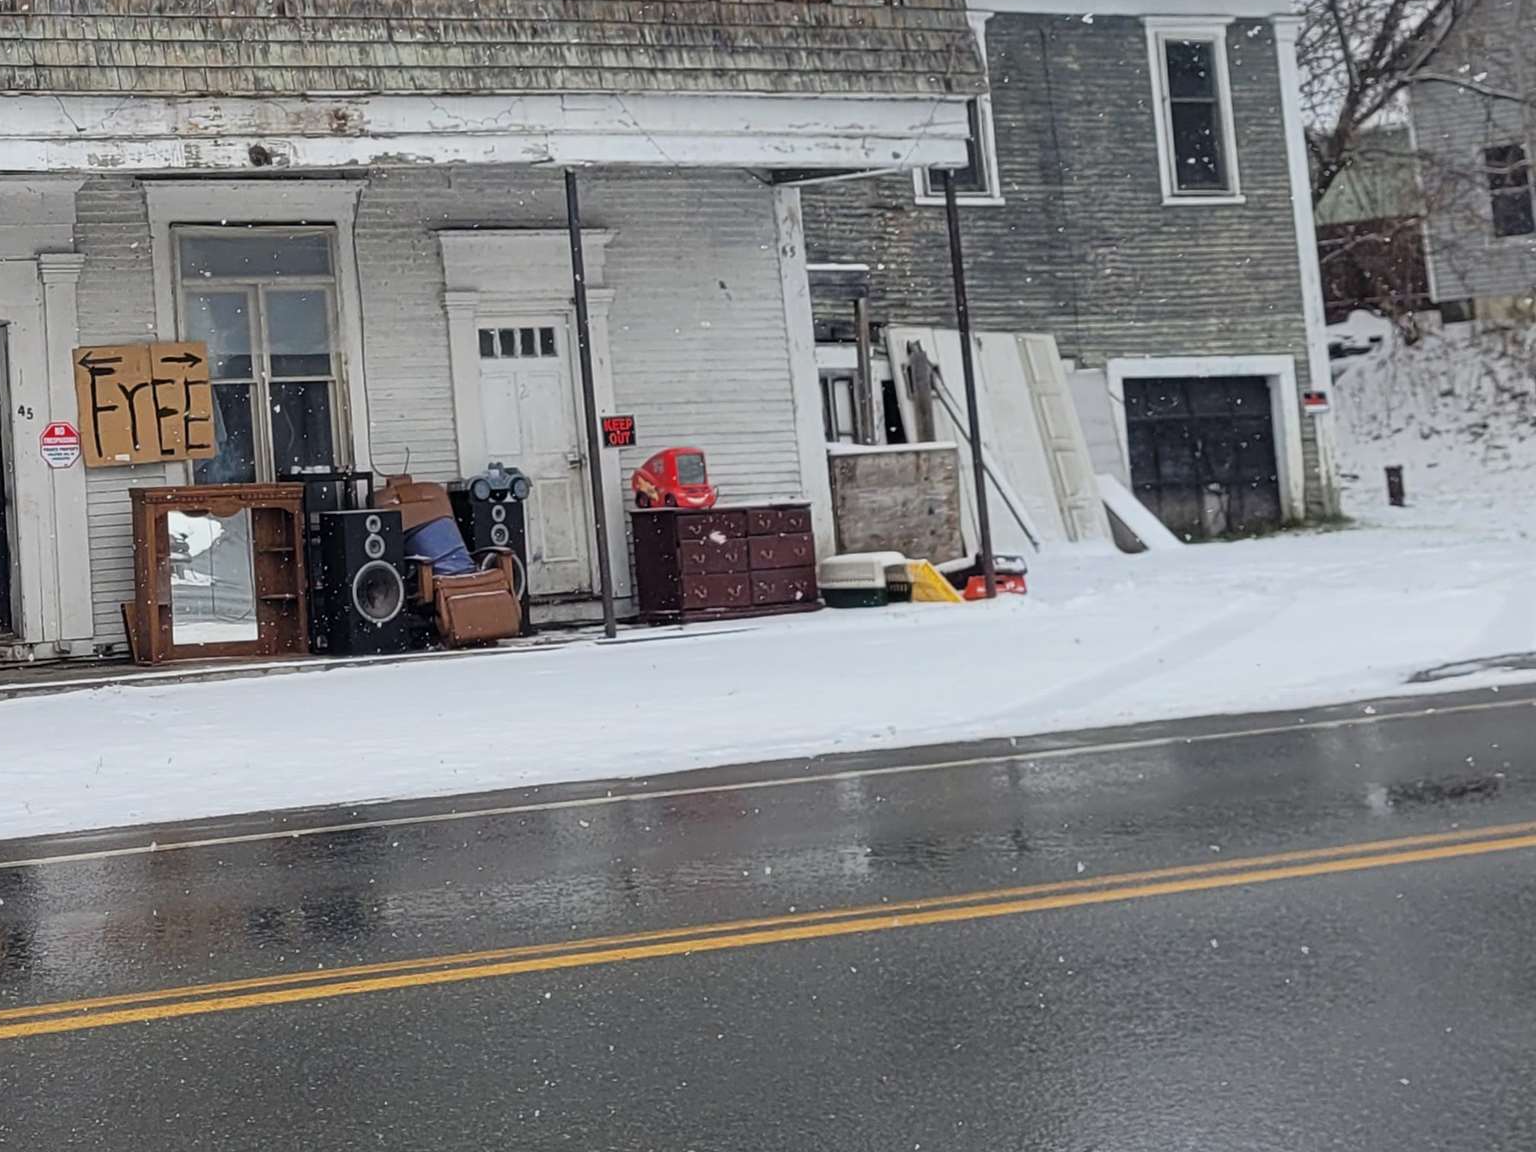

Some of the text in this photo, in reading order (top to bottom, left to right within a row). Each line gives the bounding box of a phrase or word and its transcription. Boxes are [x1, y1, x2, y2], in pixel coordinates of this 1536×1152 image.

[17, 404, 34, 420] 45
[603, 417, 632, 432] KEEP
[609, 431, 630, 446] OUT
